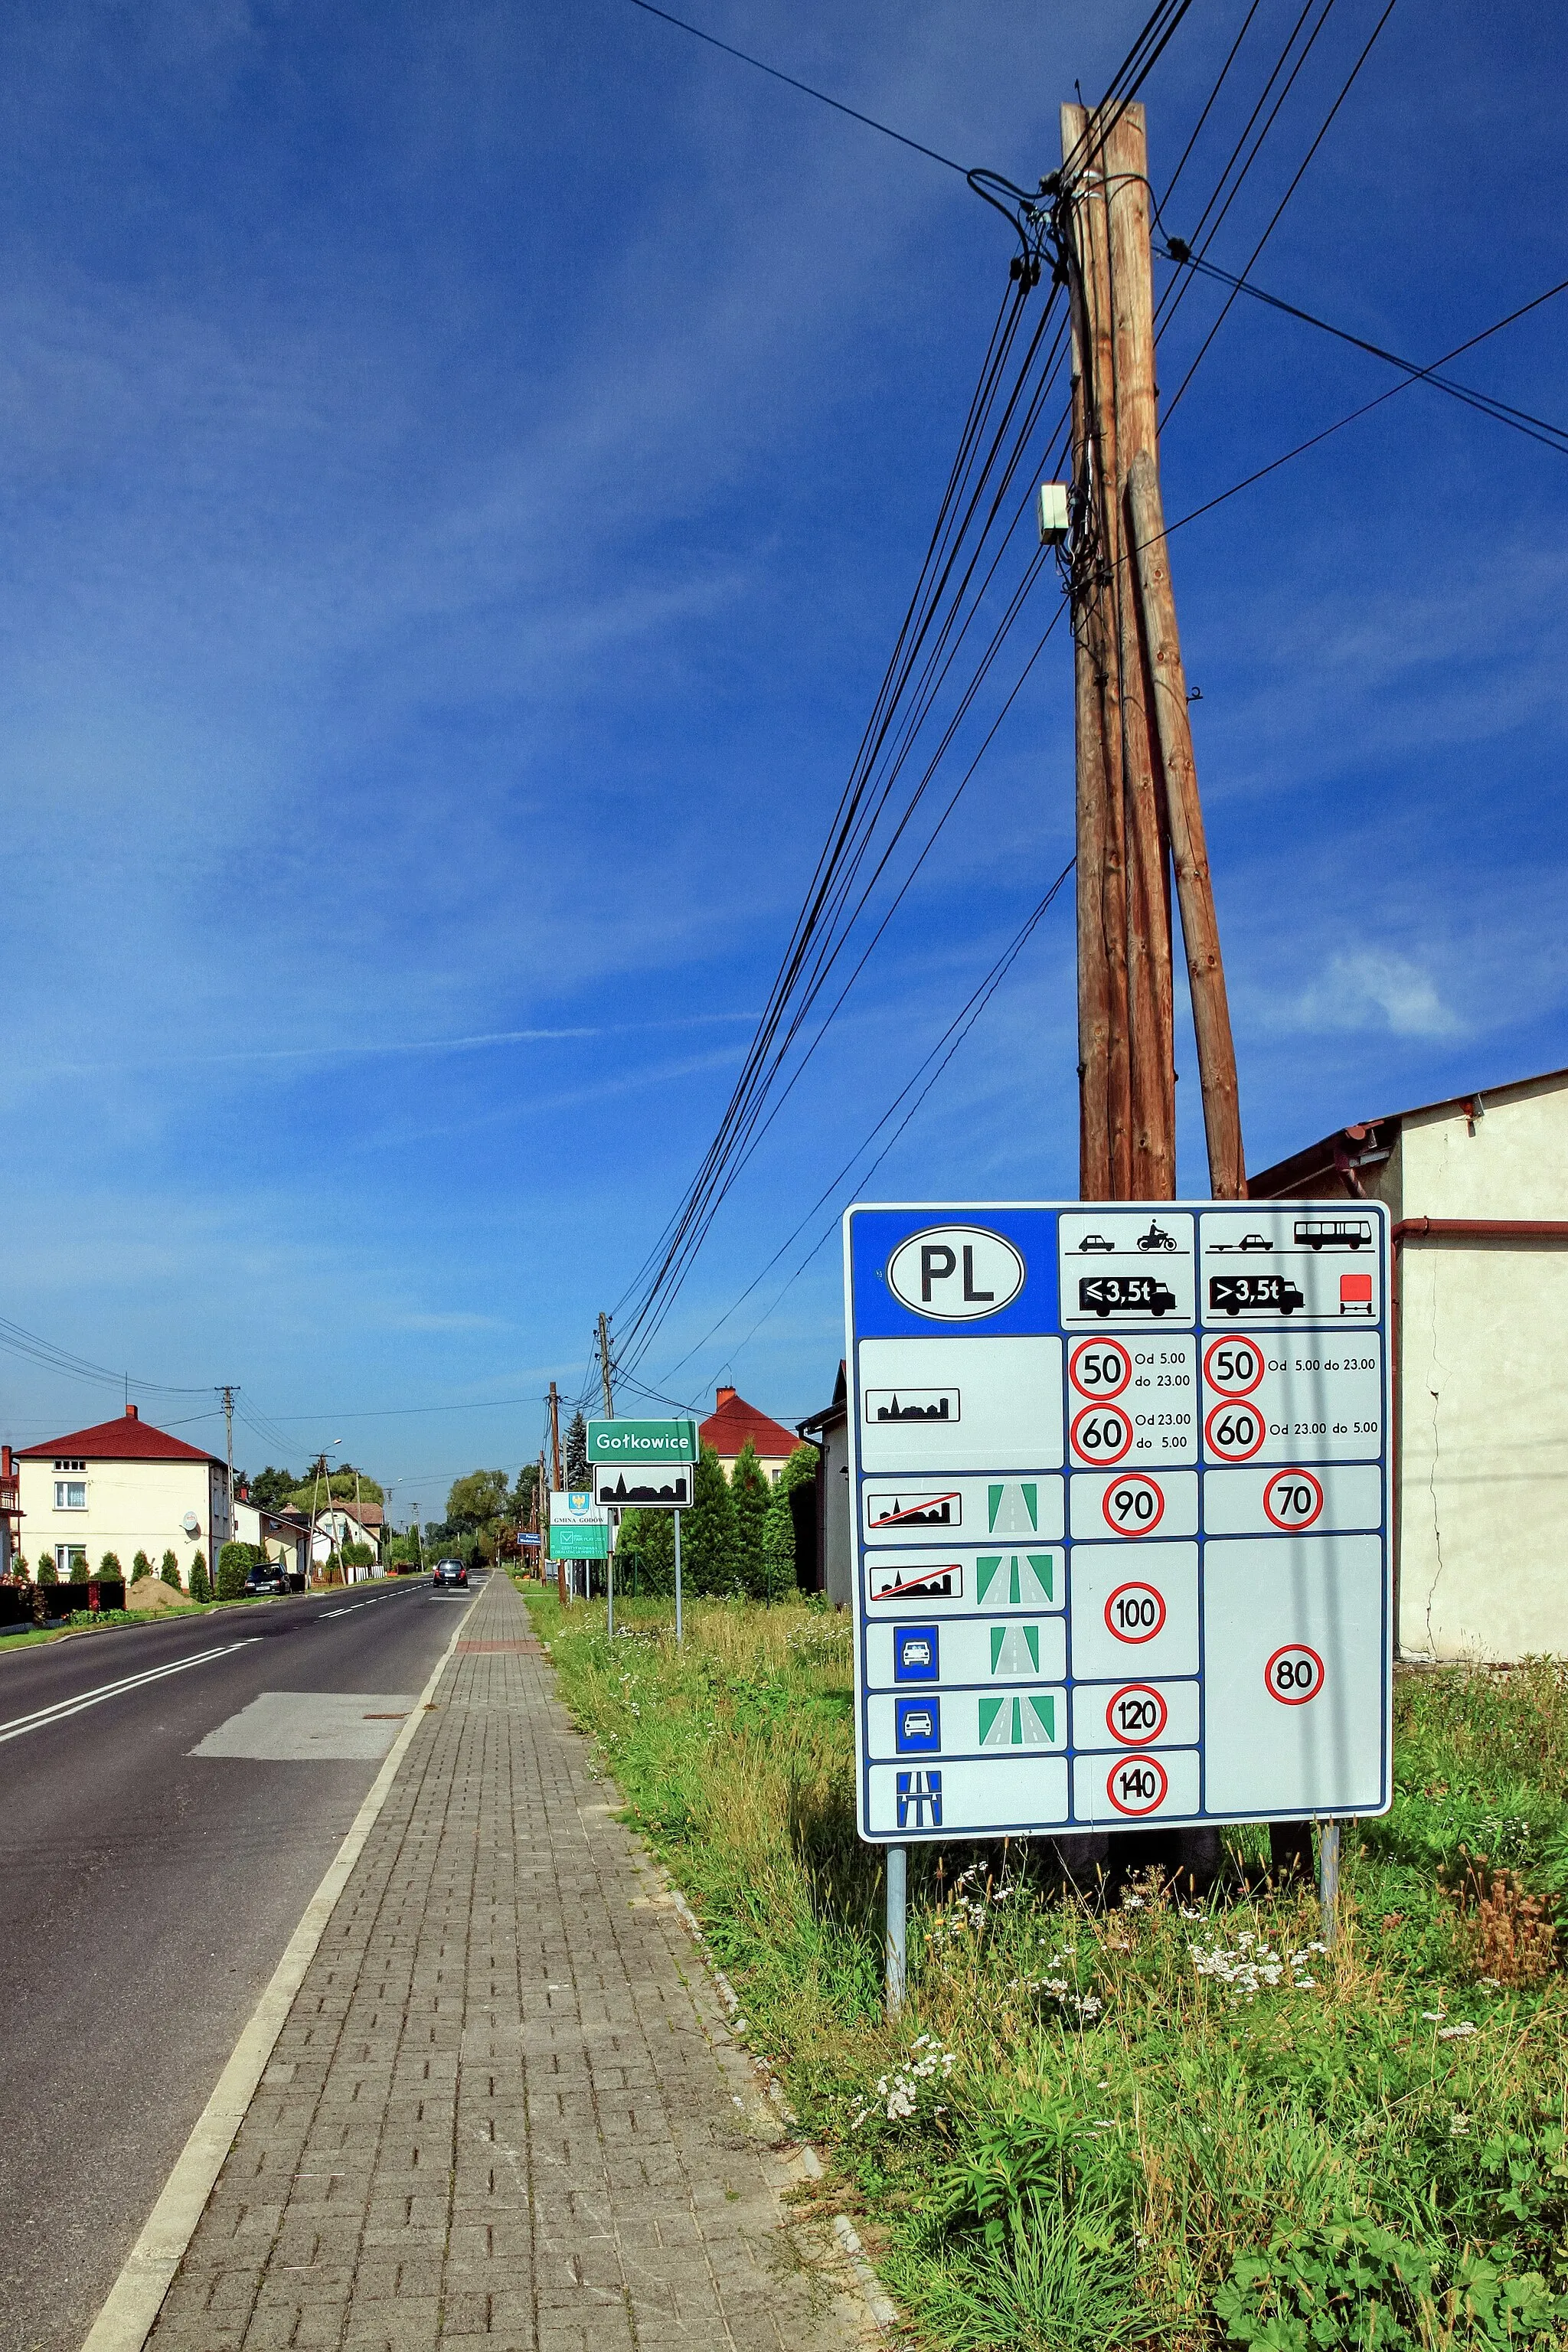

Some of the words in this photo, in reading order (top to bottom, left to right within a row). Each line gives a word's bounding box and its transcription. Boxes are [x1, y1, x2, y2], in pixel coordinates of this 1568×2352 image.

[922, 1246, 994, 1302] PL
[1084, 1354, 1121, 1383] 50
[1135, 1354, 1154, 1364] Od
[1161, 1353, 1185, 1364] 5.00
[1217, 1351, 1253, 1380] 50
[1269, 1361, 1286, 1371] Od
[1295, 1360, 1320, 1370] 5.00
[1325, 1360, 1339, 1370] do
[1344, 1359, 1375, 1370] 23.00
[1135, 1376, 1150, 1386] do
[1158, 1375, 1190, 1386] 23.00
[1083, 1419, 1122, 1448] 60
[1135, 1415, 1154, 1426] Od
[1158, 1414, 1191, 1425] 23.00
[1217, 1416, 1253, 1445] 60
[1270, 1424, 1288, 1435] Od
[1295, 1423, 1326, 1434] 23.00
[1333, 1423, 1348, 1433] do
[1354, 1422, 1377, 1432] 5.00
[596, 1433, 689, 1449] Gołkowice
[1137, 1438, 1152, 1448] do
[1162, 1436, 1187, 1448] 5.00
[1116, 1491, 1153, 1521] 90
[1278, 1486, 1311, 1514] 70
[1117, 1599, 1155, 1627] 100
[1277, 1661, 1312, 1689] 80
[1119, 1700, 1156, 1730] 120
[1120, 1769, 1155, 1799] 140
